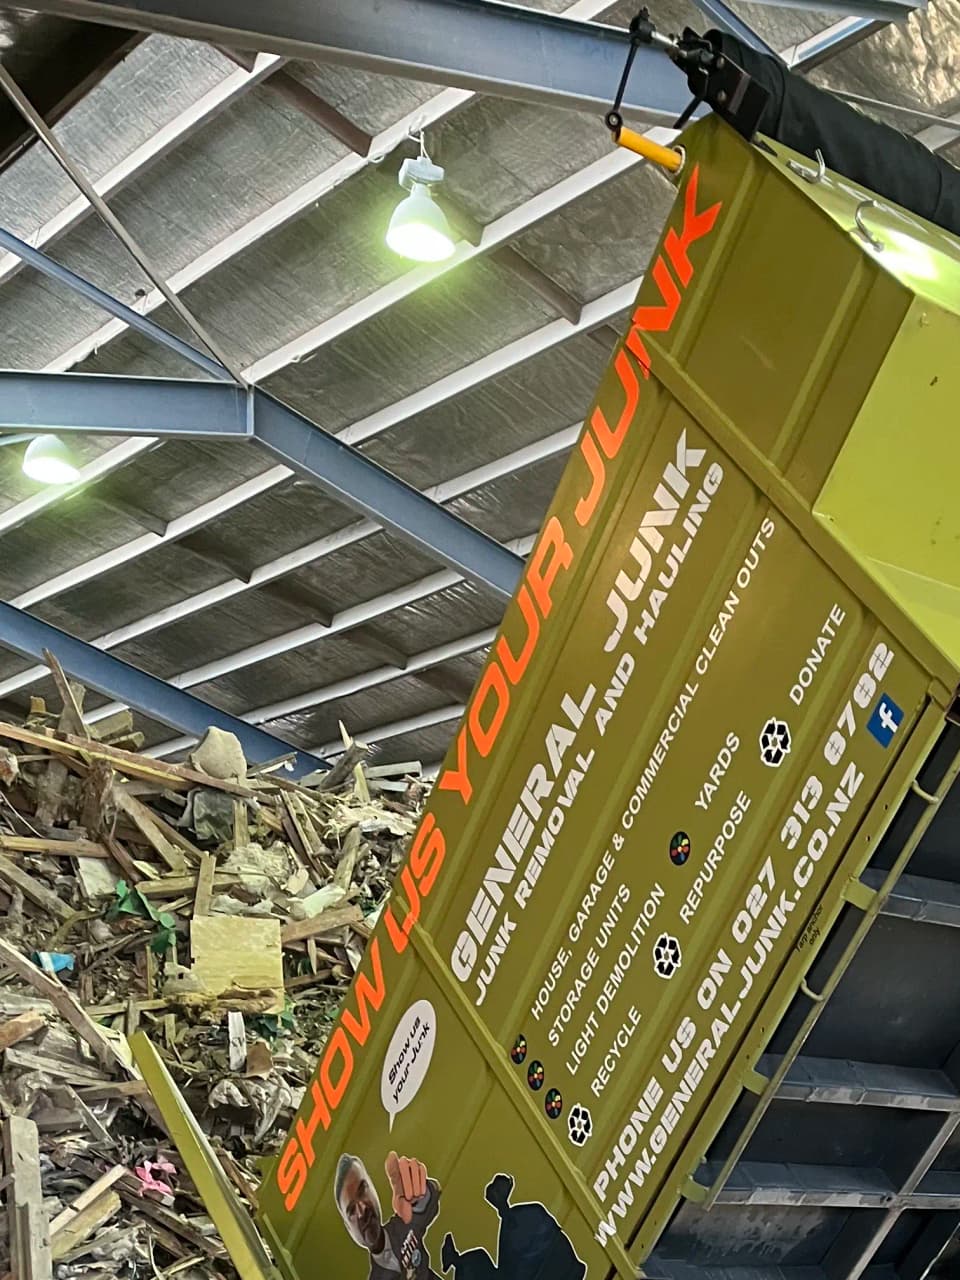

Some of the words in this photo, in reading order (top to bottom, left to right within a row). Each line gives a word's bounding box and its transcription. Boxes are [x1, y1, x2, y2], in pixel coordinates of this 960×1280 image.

[277, 937, 386, 1211] SHOW
[385, 812, 447, 954] US
[440, 515, 574, 805] YOUR
[577, 161, 722, 526] JUNK
[451, 684, 596, 984] GENERAL
[604, 428, 706, 652] JUNK
[476, 913, 517, 1006] JUNK
[514, 748, 595, 909] REMOVAL
[595, 653, 635, 736] AND
[634, 463, 723, 645] HAULING
[789, 604, 846, 705] DONATE
[531, 947, 573, 1020] HOUSE,
[568, 852, 615, 942] GARAGE
[612, 833, 625, 851] &
[622, 684, 698, 829] COMMERCIAL
[695, 592, 739, 675] CLEAN
[738, 518, 775, 588] OUTS
[694, 732, 740, 810] YARDS
[593, 1076, 664, 1202] PHONE
[661, 1016, 697, 1073] US
[697, 948, 733, 1010] ON
[731, 856, 776, 944] 027
[780, 775, 823, 850] 313
[823, 643, 895, 766] 8782
[680, 791, 752, 925] REPURPOSE
[388, 1037, 410, 1085] Show
[411, 1016, 421, 1038] us
[548, 947, 599, 1047] STORAGE
[596, 884, 630, 949] UNITS
[566, 1011, 599, 1075] LIGHT
[597, 884, 665, 1015] DEMOLITION
[591, 1006, 641, 1097] RECYCLE
[593, 762, 864, 1247] WWW.GENERALJUNK.CO.NZ
[392, 1063, 410, 1104] your
